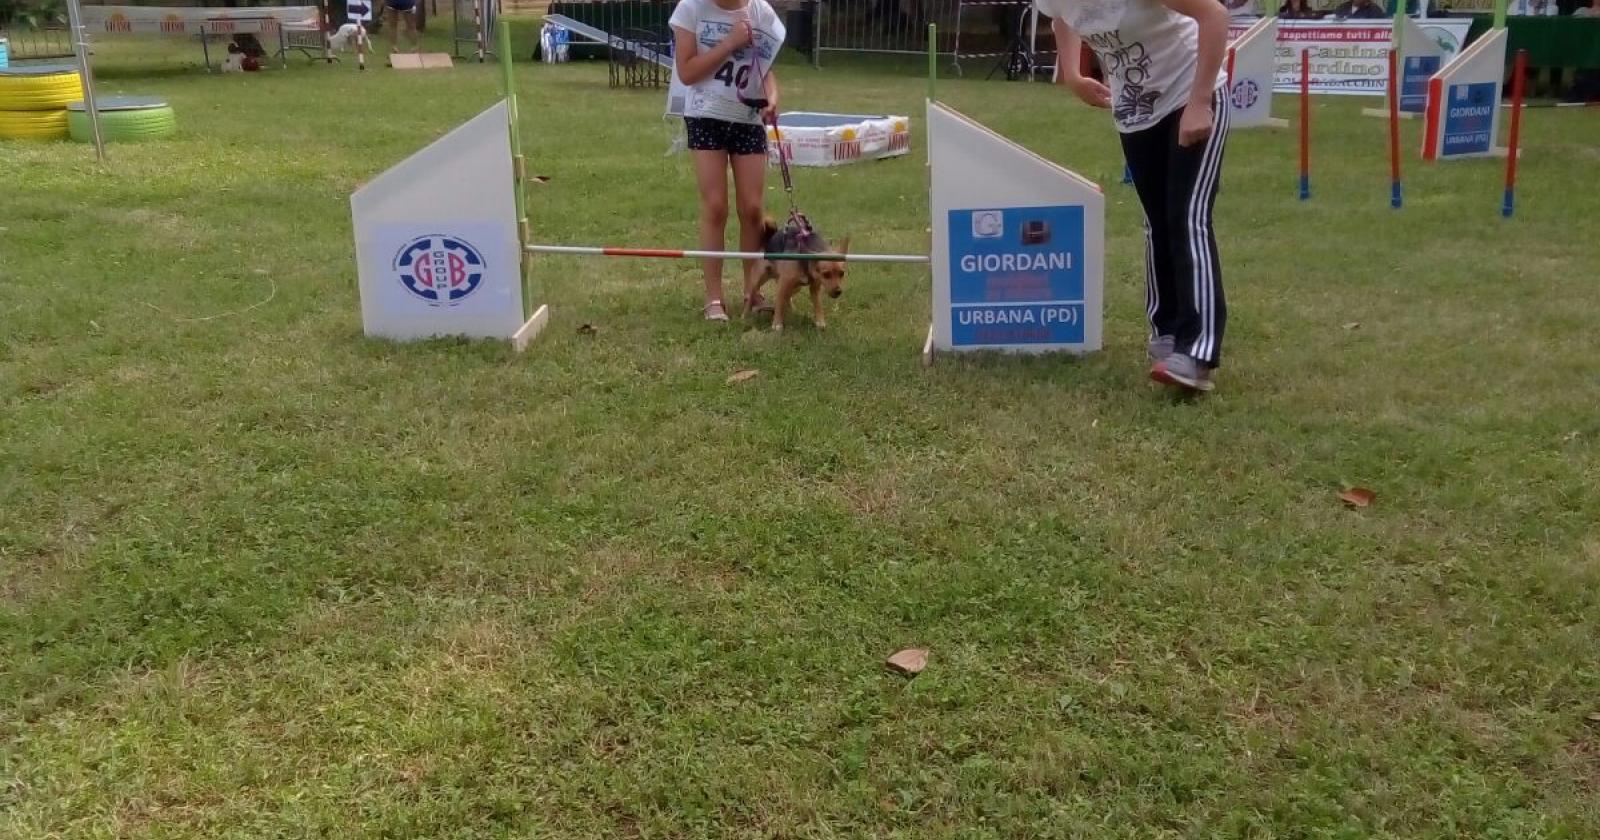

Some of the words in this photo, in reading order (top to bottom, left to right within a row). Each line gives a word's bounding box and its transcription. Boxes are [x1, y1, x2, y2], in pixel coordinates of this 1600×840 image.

[1346, 31, 1371, 40] tutti
[714, 60, 753, 89] 40
[432, 250, 448, 289] GROUP
[960, 252, 1072, 272] GIORDANI
[959, 309, 1036, 325] URBANA
[1040, 306, 1078, 327] (PD)
